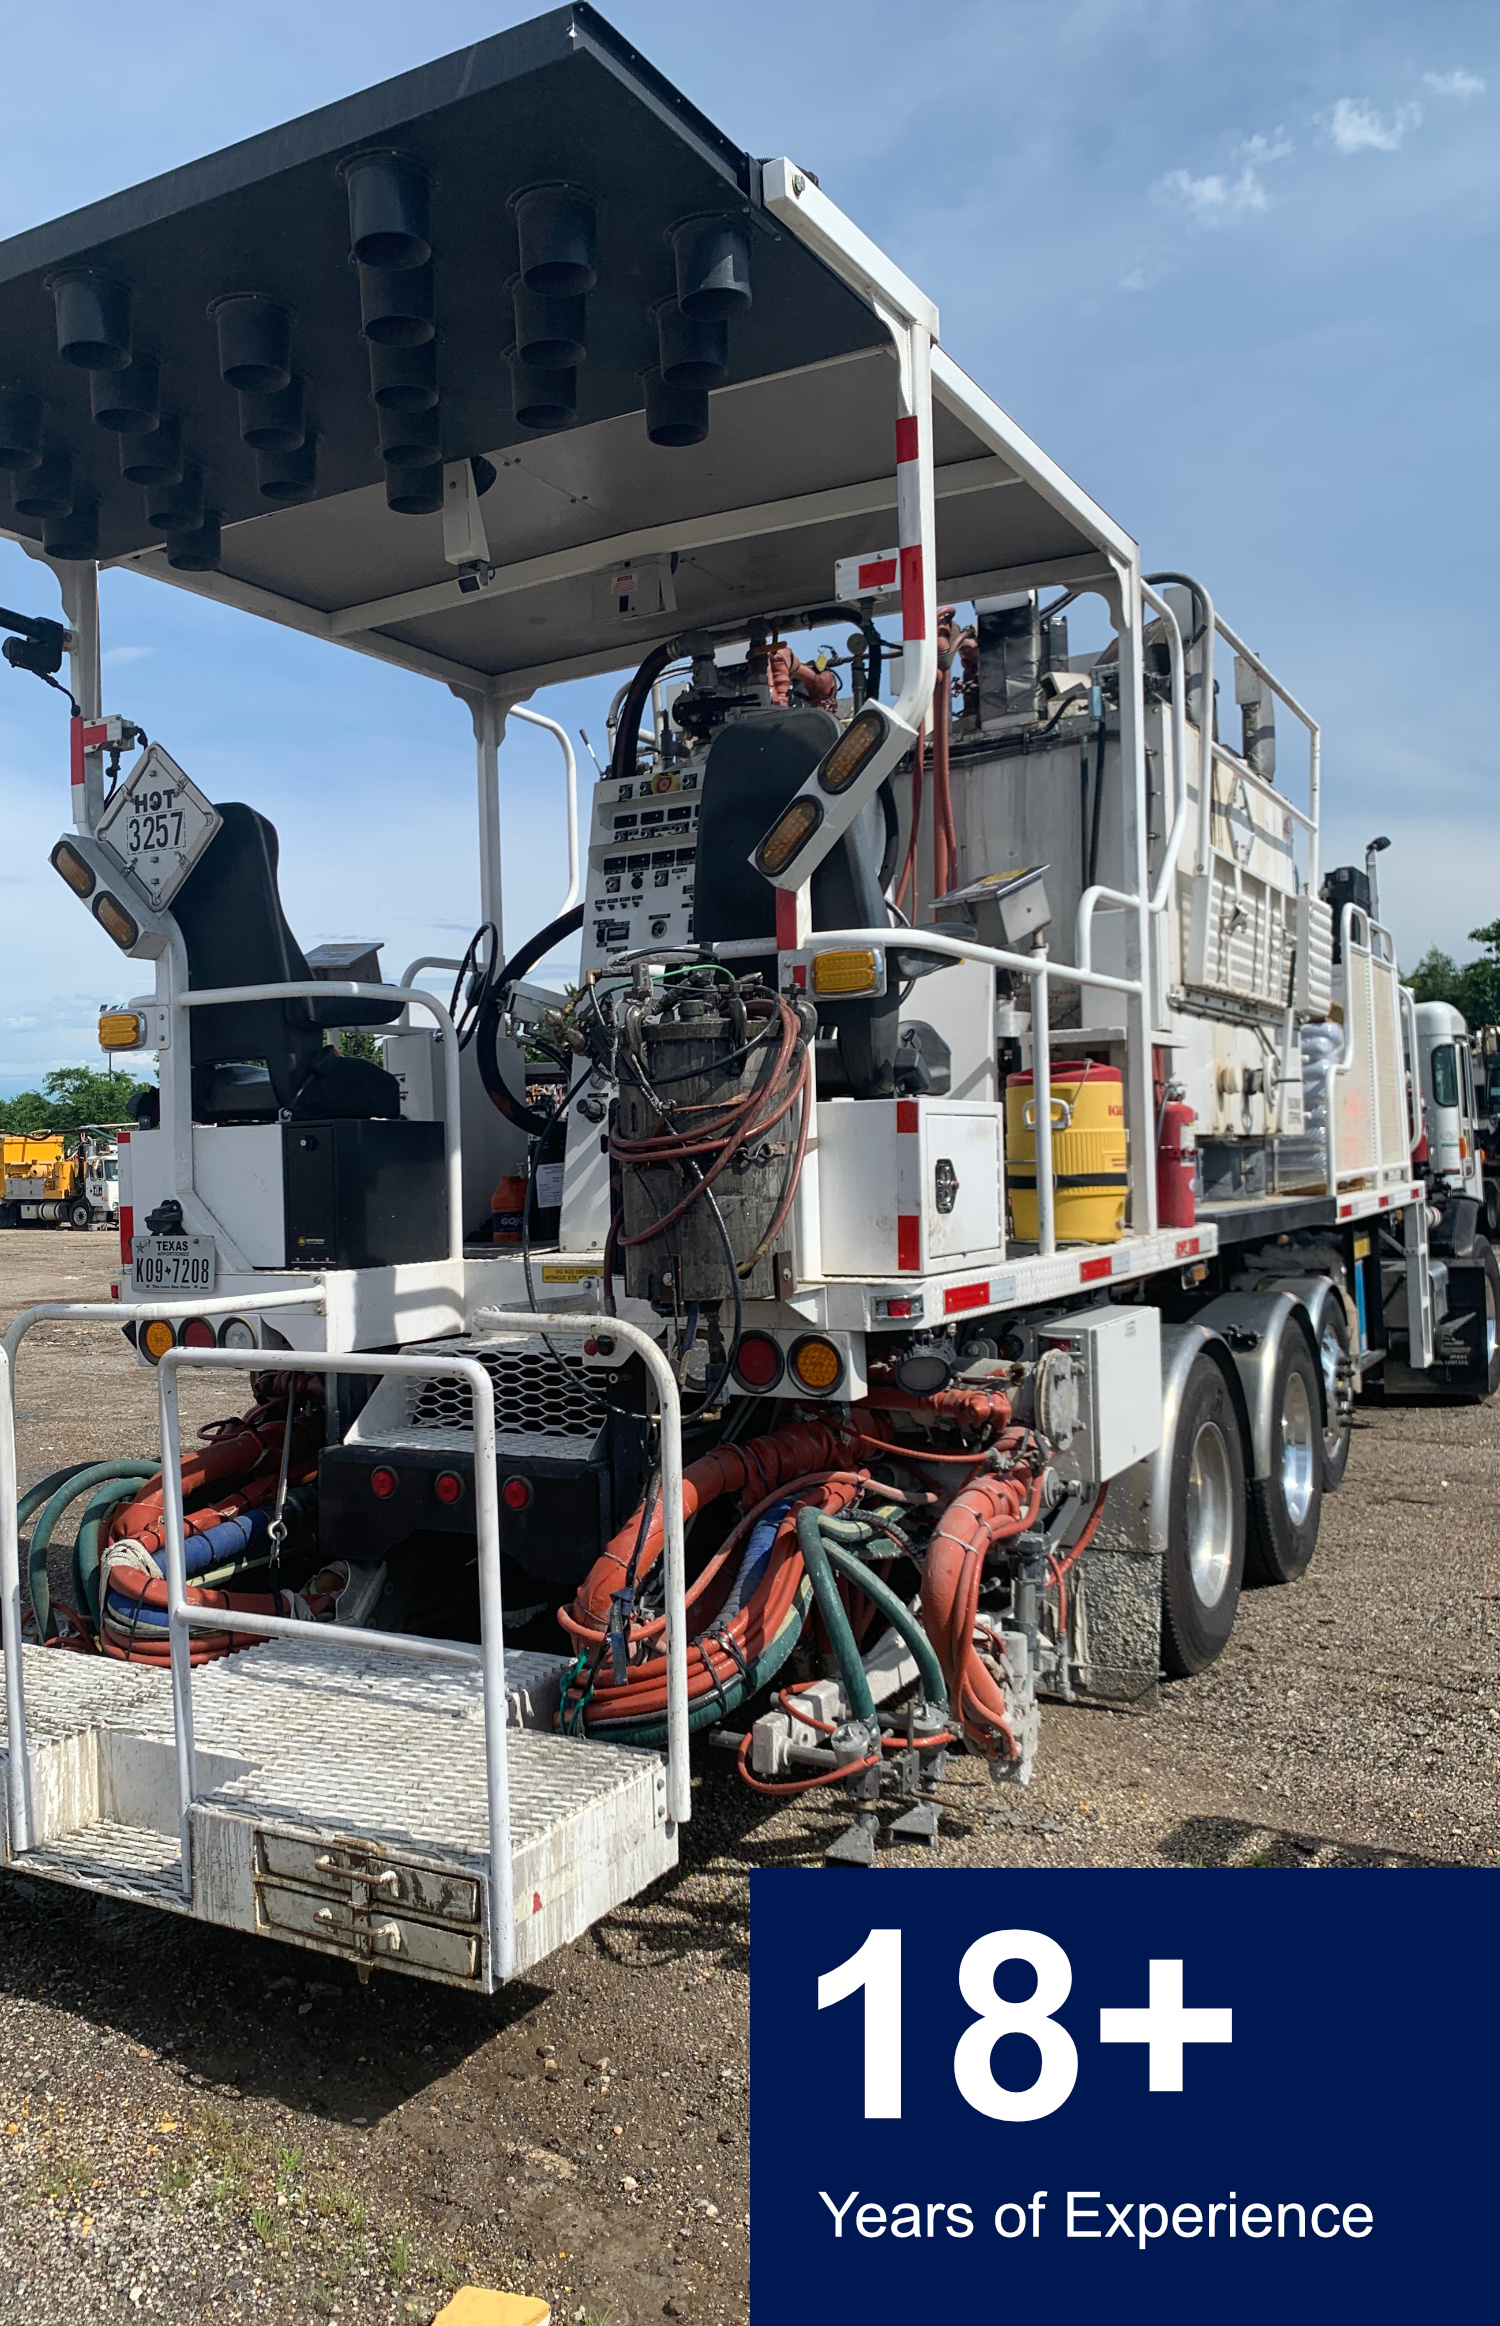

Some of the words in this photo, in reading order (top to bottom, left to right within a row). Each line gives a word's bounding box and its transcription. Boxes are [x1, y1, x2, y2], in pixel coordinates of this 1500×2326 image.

[135, 789, 175, 814] HOT
[128, 811, 183, 852] 3257
[156, 1241, 188, 1251] TEXAS
